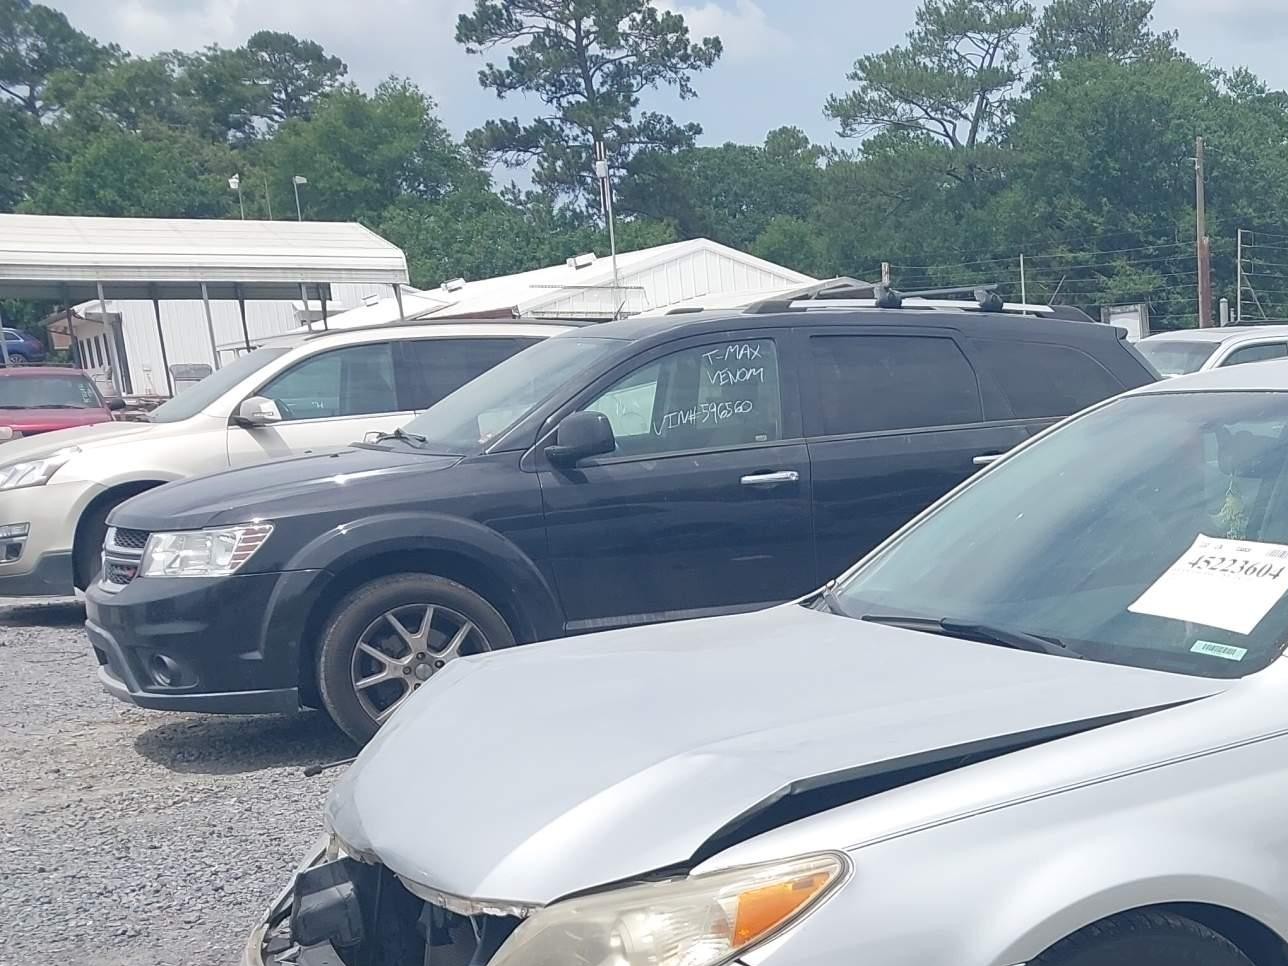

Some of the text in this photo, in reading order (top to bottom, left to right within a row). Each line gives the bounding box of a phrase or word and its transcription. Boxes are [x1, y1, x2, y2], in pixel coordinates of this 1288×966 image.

[702, 344, 762, 365] T-MAX
[706, 367, 764, 386] VENOM
[1188, 555, 1286, 580] 45223604
